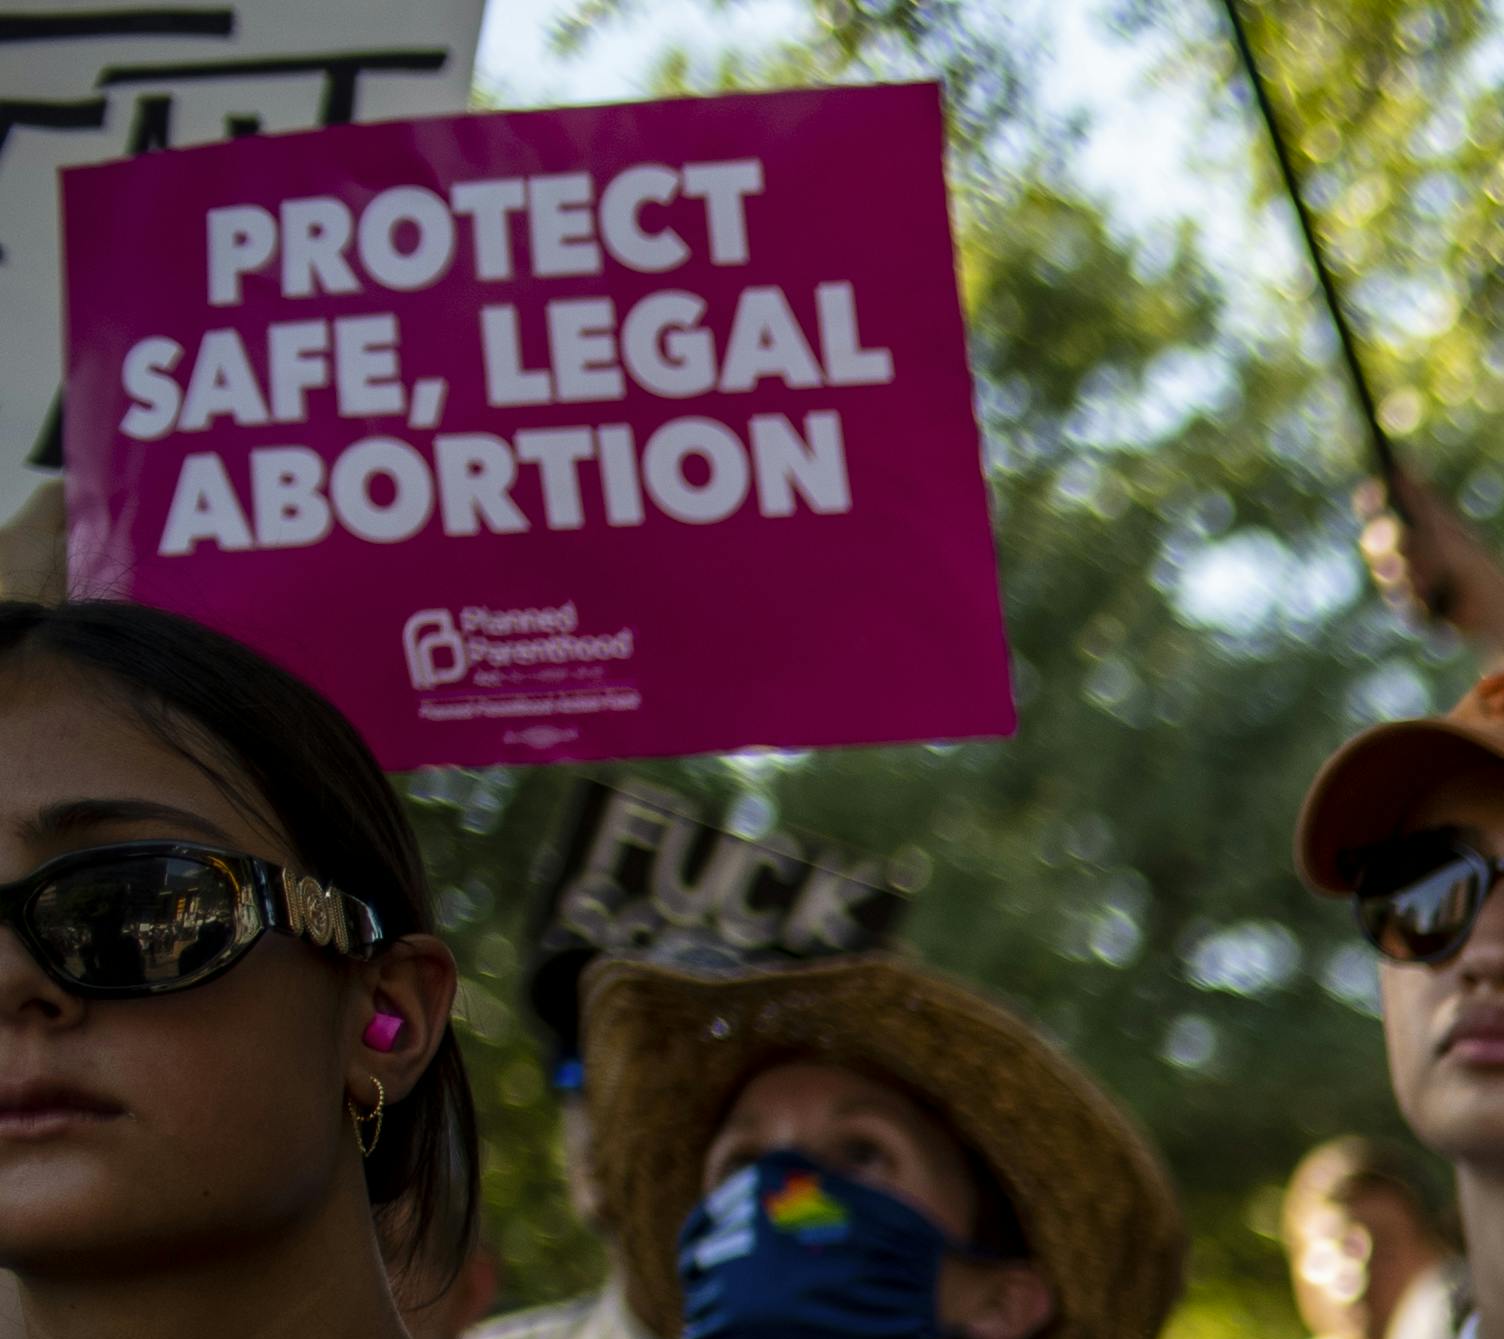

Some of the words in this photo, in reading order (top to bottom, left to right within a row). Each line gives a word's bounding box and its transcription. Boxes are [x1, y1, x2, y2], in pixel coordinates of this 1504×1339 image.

[206, 159, 763, 306] PROTECT
[119, 313, 448, 440] SAFE,
[481, 281, 894, 408] LEGAL
[158, 411, 852, 557] ABORTION
[582, 776, 888, 958] FUCK
